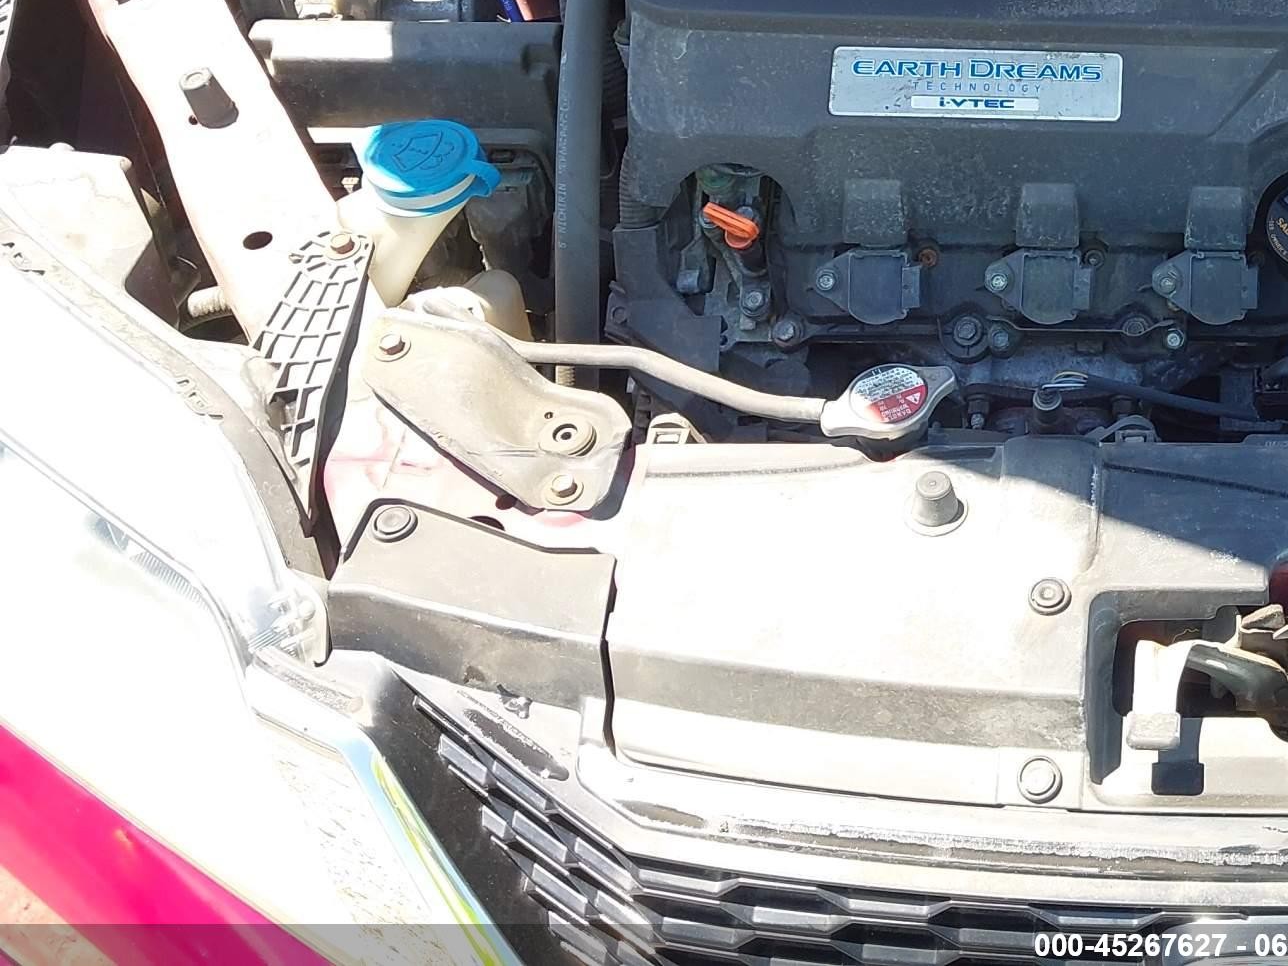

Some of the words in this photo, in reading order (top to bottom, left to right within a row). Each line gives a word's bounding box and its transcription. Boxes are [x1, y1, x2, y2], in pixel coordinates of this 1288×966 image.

[852, 59, 961, 77] EARTH
[969, 59, 1102, 81] DREAMS
[913, 81, 1042, 93] TECHNOLOGY
[939, 96, 1015, 109] i-VTEC
